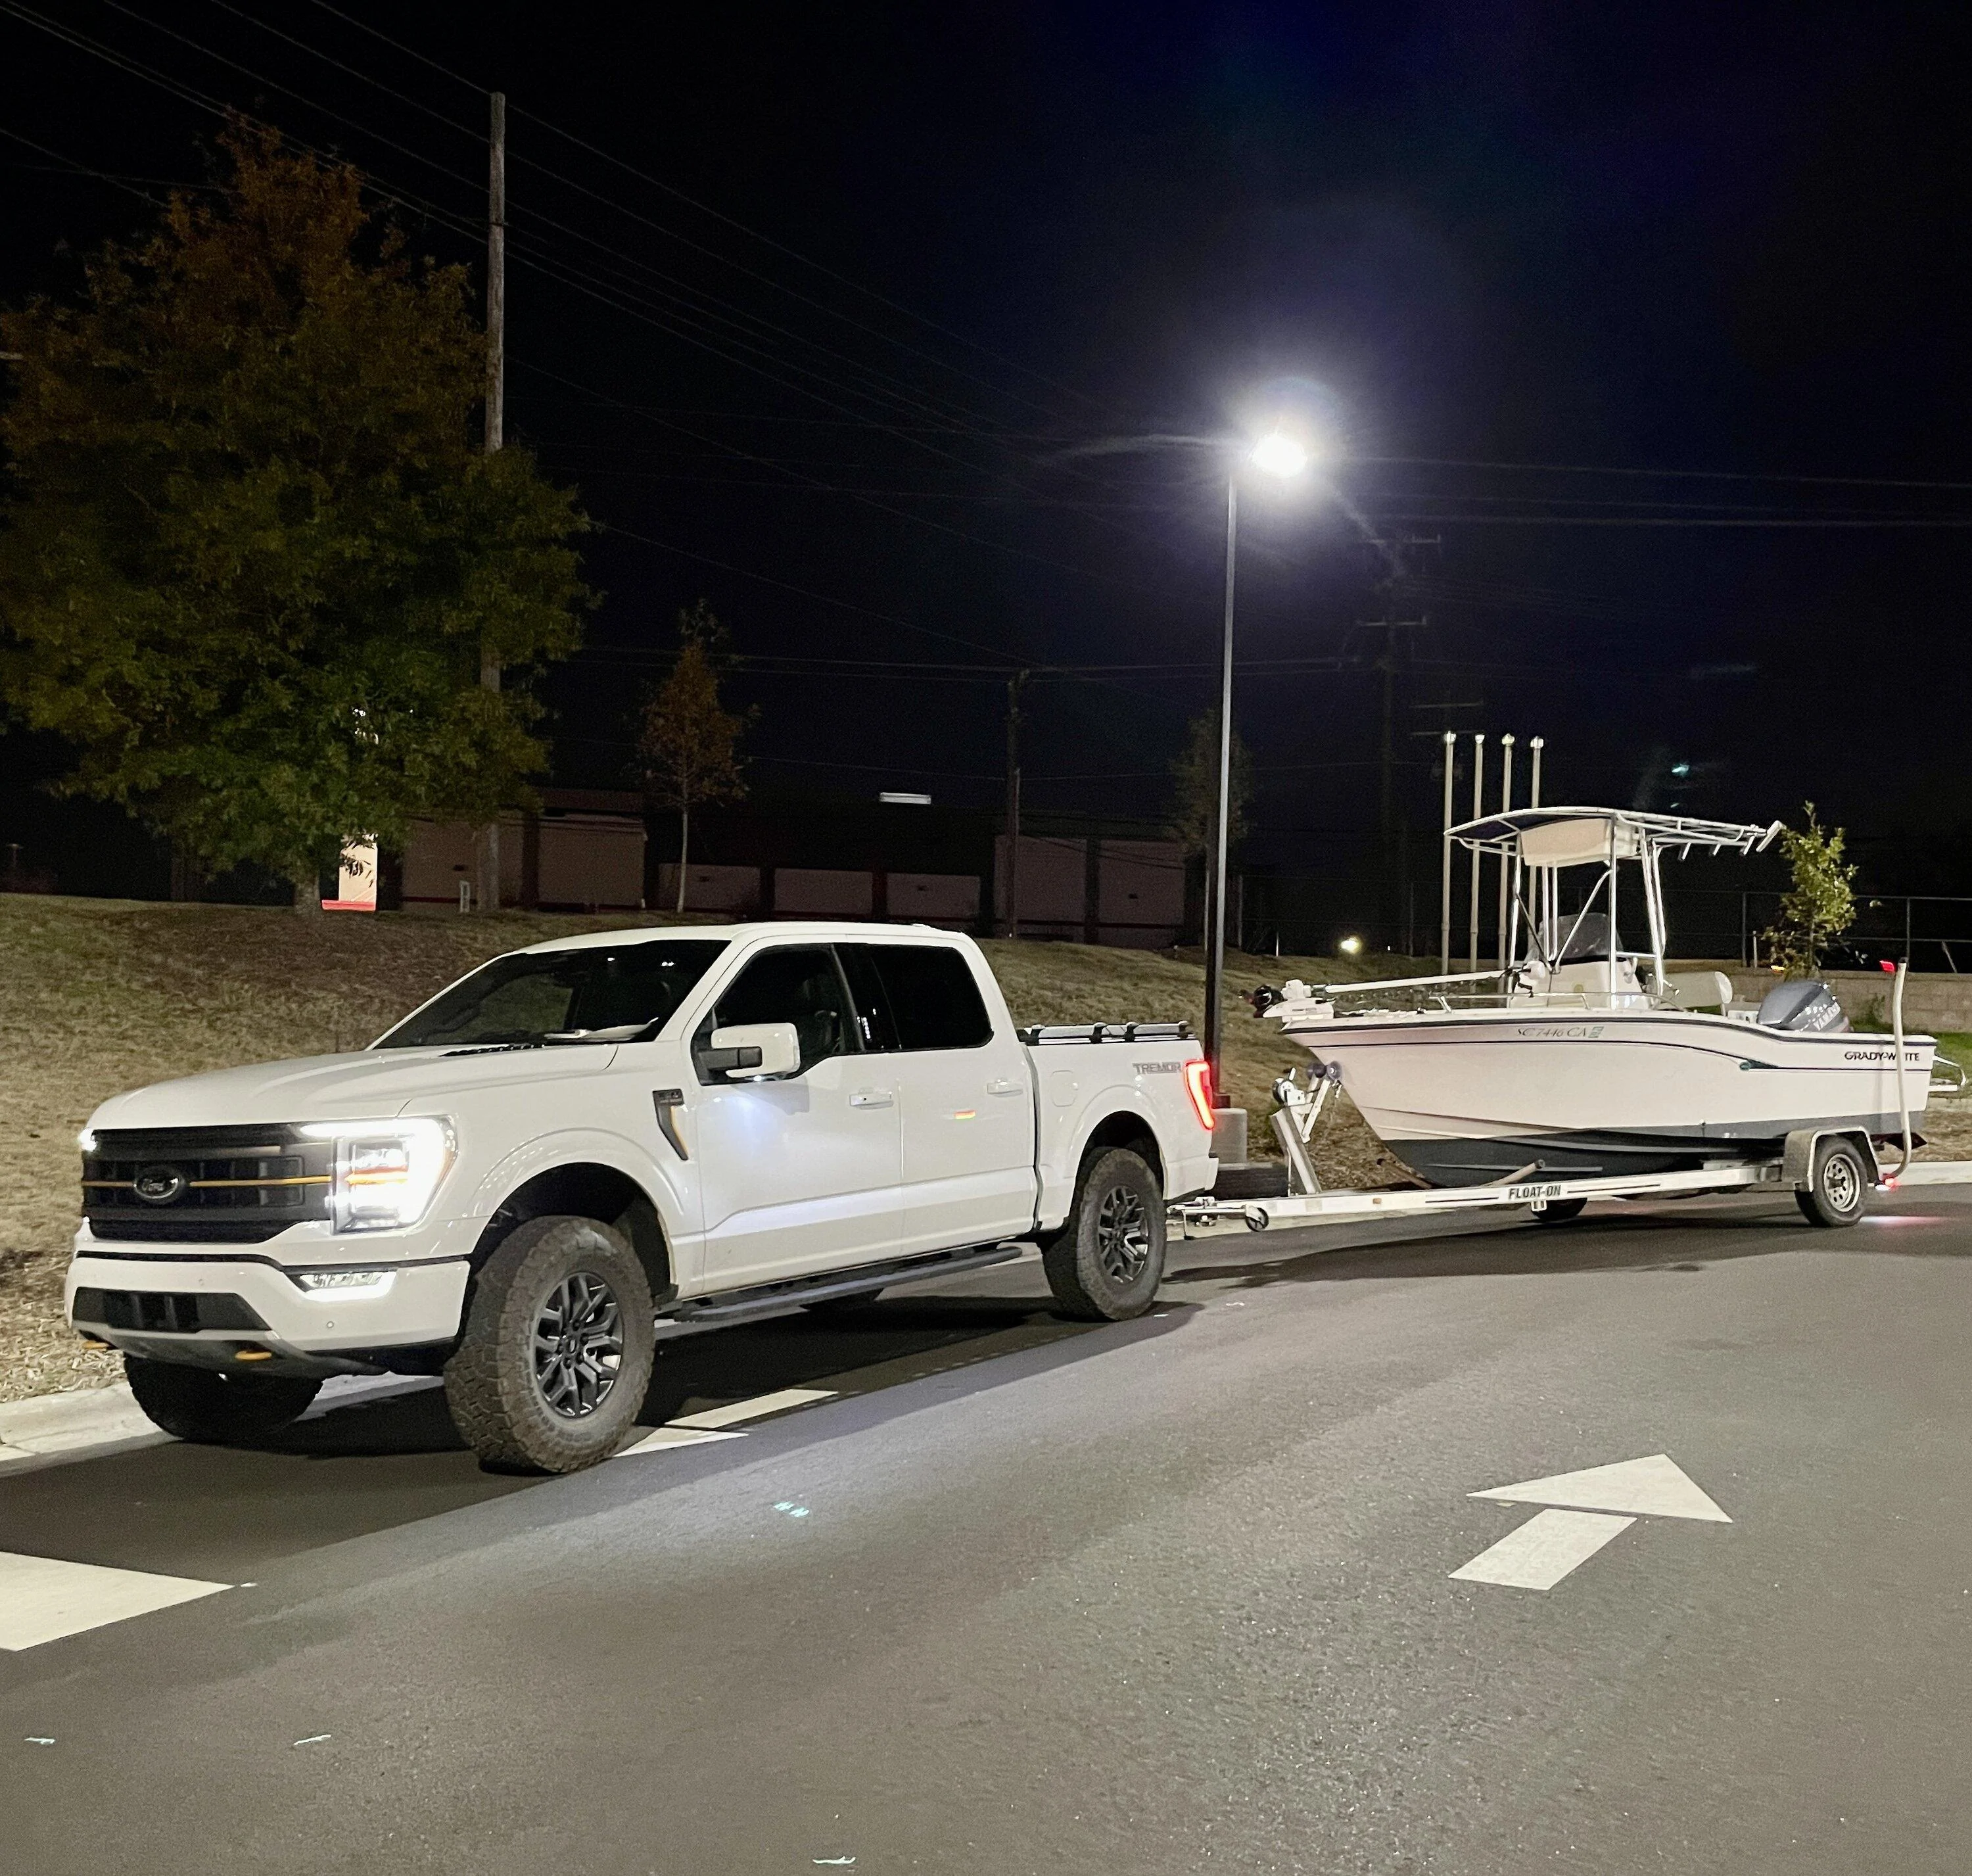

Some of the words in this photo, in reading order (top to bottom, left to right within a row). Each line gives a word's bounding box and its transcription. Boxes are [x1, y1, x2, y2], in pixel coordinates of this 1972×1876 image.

[1844, 1052, 1919, 1061] GRADY-WITE
[1133, 1062, 1181, 1074] TREMOR
[1509, 1185, 1561, 1199] FLOAT-ON
